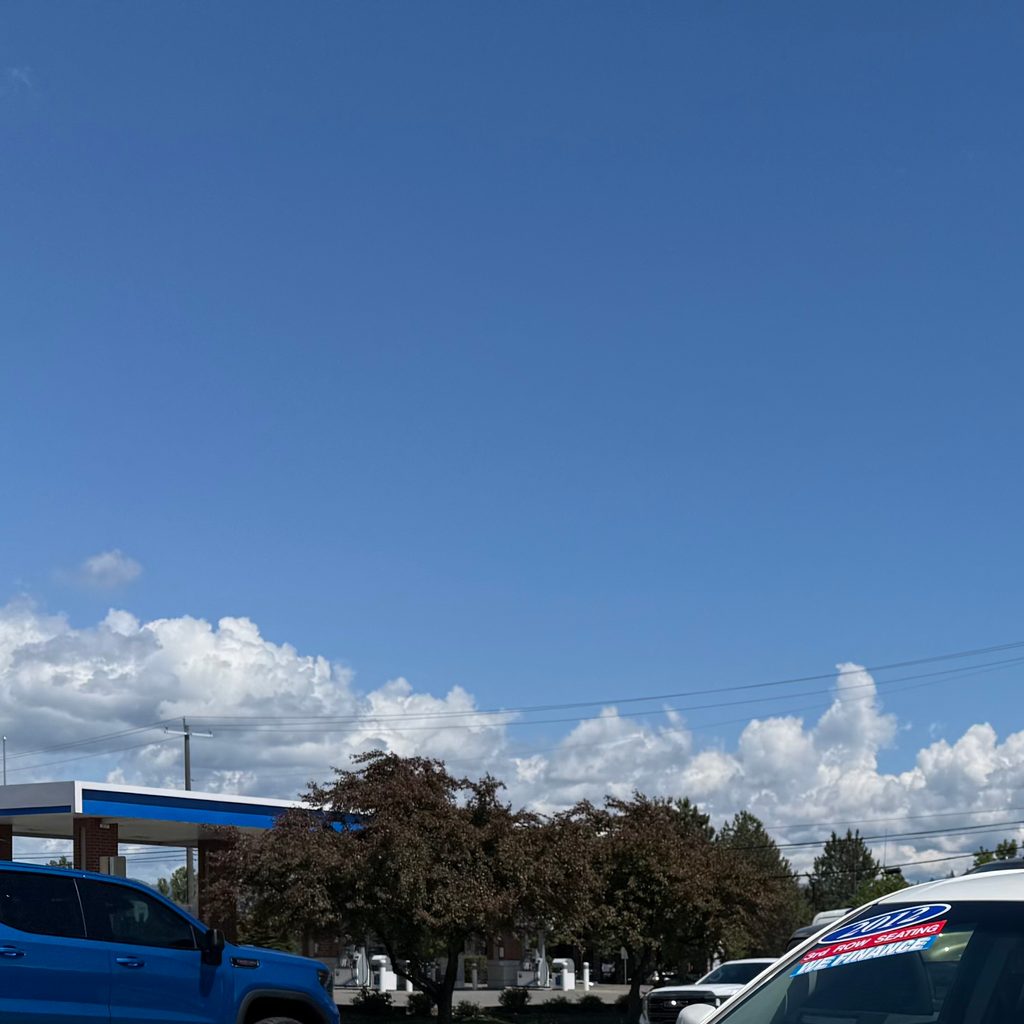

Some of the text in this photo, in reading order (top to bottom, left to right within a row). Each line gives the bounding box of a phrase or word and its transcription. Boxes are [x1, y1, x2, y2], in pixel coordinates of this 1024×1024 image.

[836, 905, 931, 940] 2012
[797, 936, 932, 975] WE FINANCE
[803, 923, 941, 961] 3rd ROW SEATING
